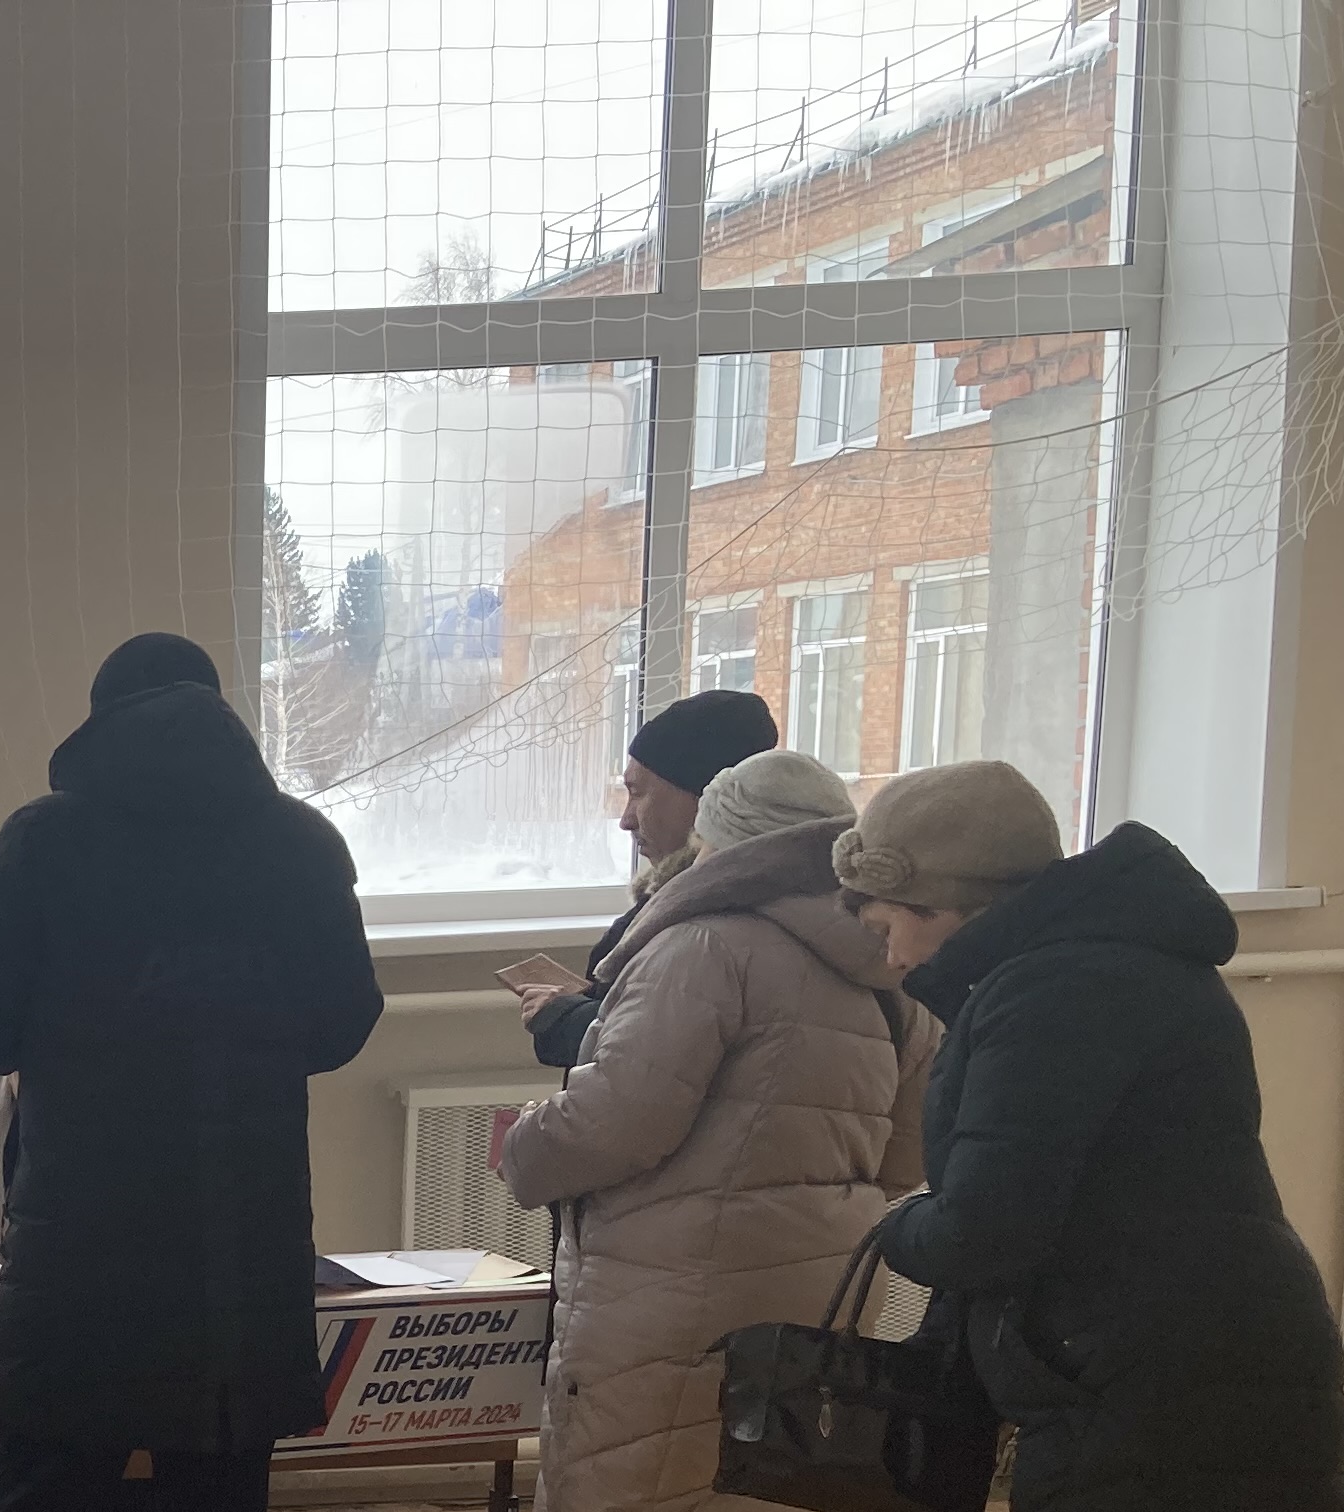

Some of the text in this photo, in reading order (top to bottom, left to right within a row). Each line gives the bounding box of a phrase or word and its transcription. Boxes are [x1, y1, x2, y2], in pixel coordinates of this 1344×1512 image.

[388, 1308, 519, 1339] ВЫБОРЫ
[357, 1376, 474, 1406] РОССИИ
[404, 1407, 471, 1432] МАРТА
[472, 1402, 523, 1427] 2024
